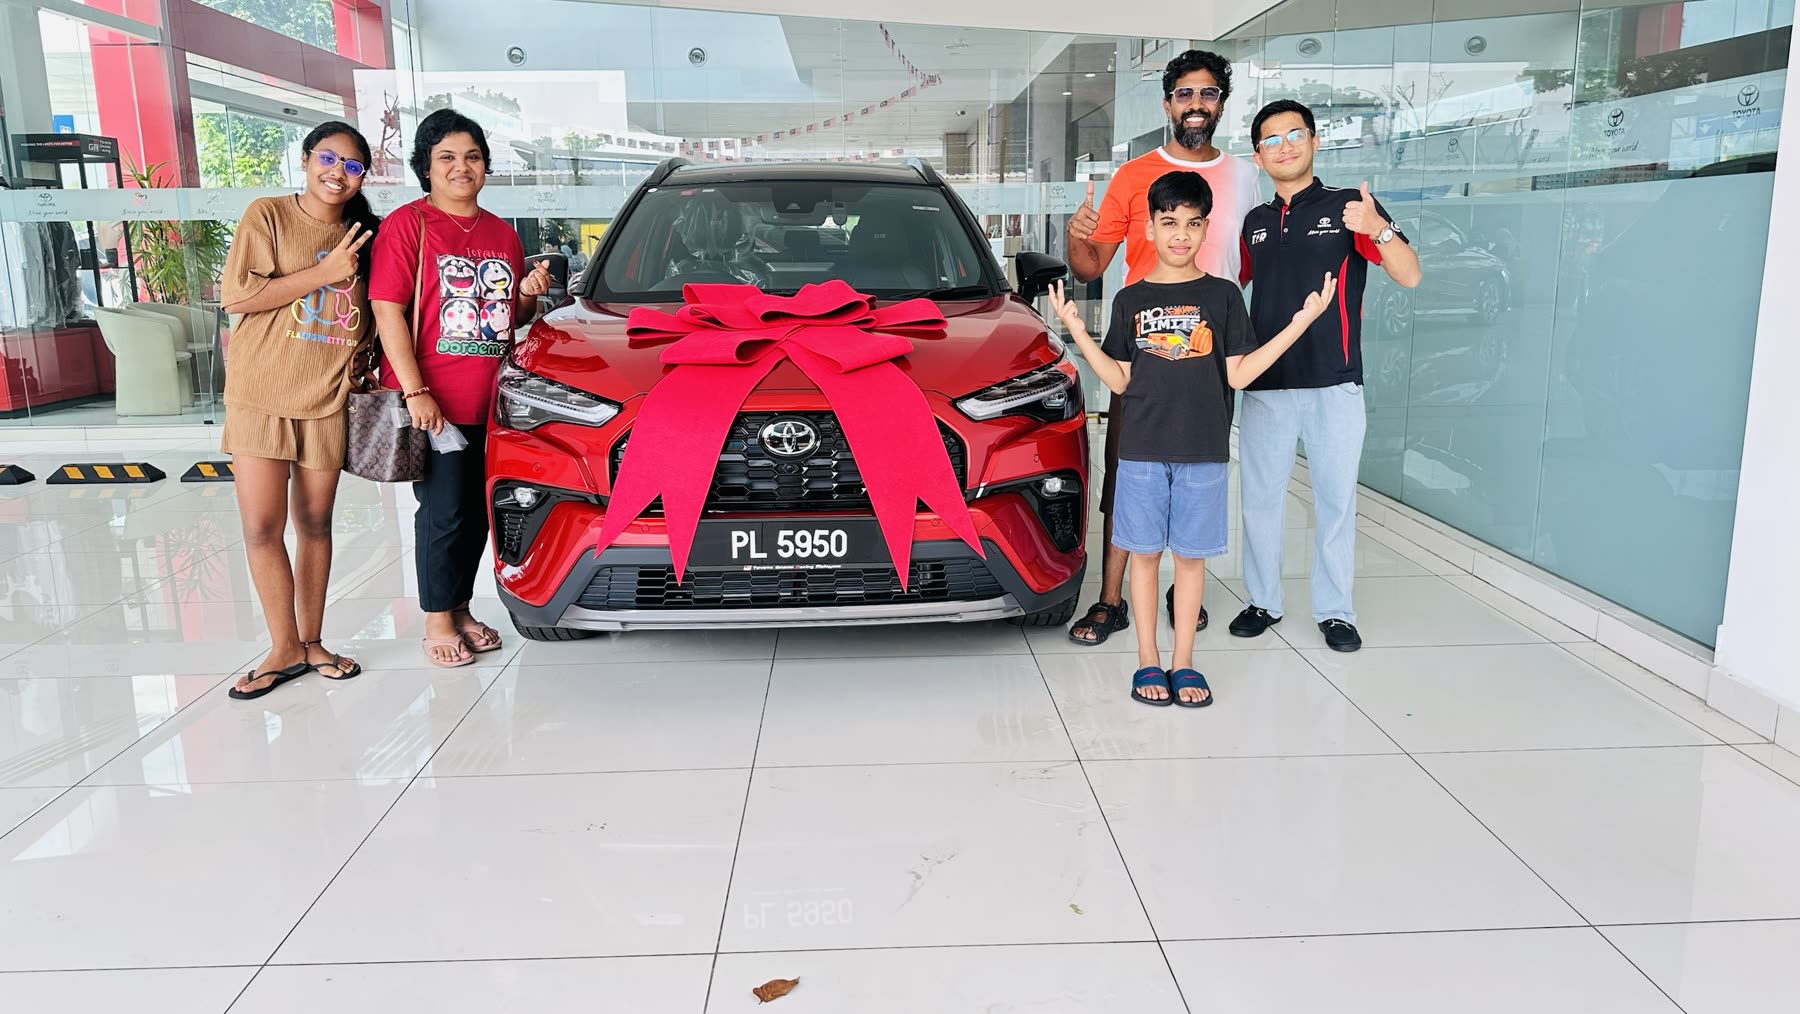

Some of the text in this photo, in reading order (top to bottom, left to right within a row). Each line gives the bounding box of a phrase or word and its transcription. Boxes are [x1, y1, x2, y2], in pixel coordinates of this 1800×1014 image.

[1732, 107, 1761, 119] TOYOTA
[1604, 128, 1625, 137] TOYOTA
[88, 143, 100, 152] GR
[1141, 307, 1164, 322] NO
[731, 529, 848, 559] PL 5950
